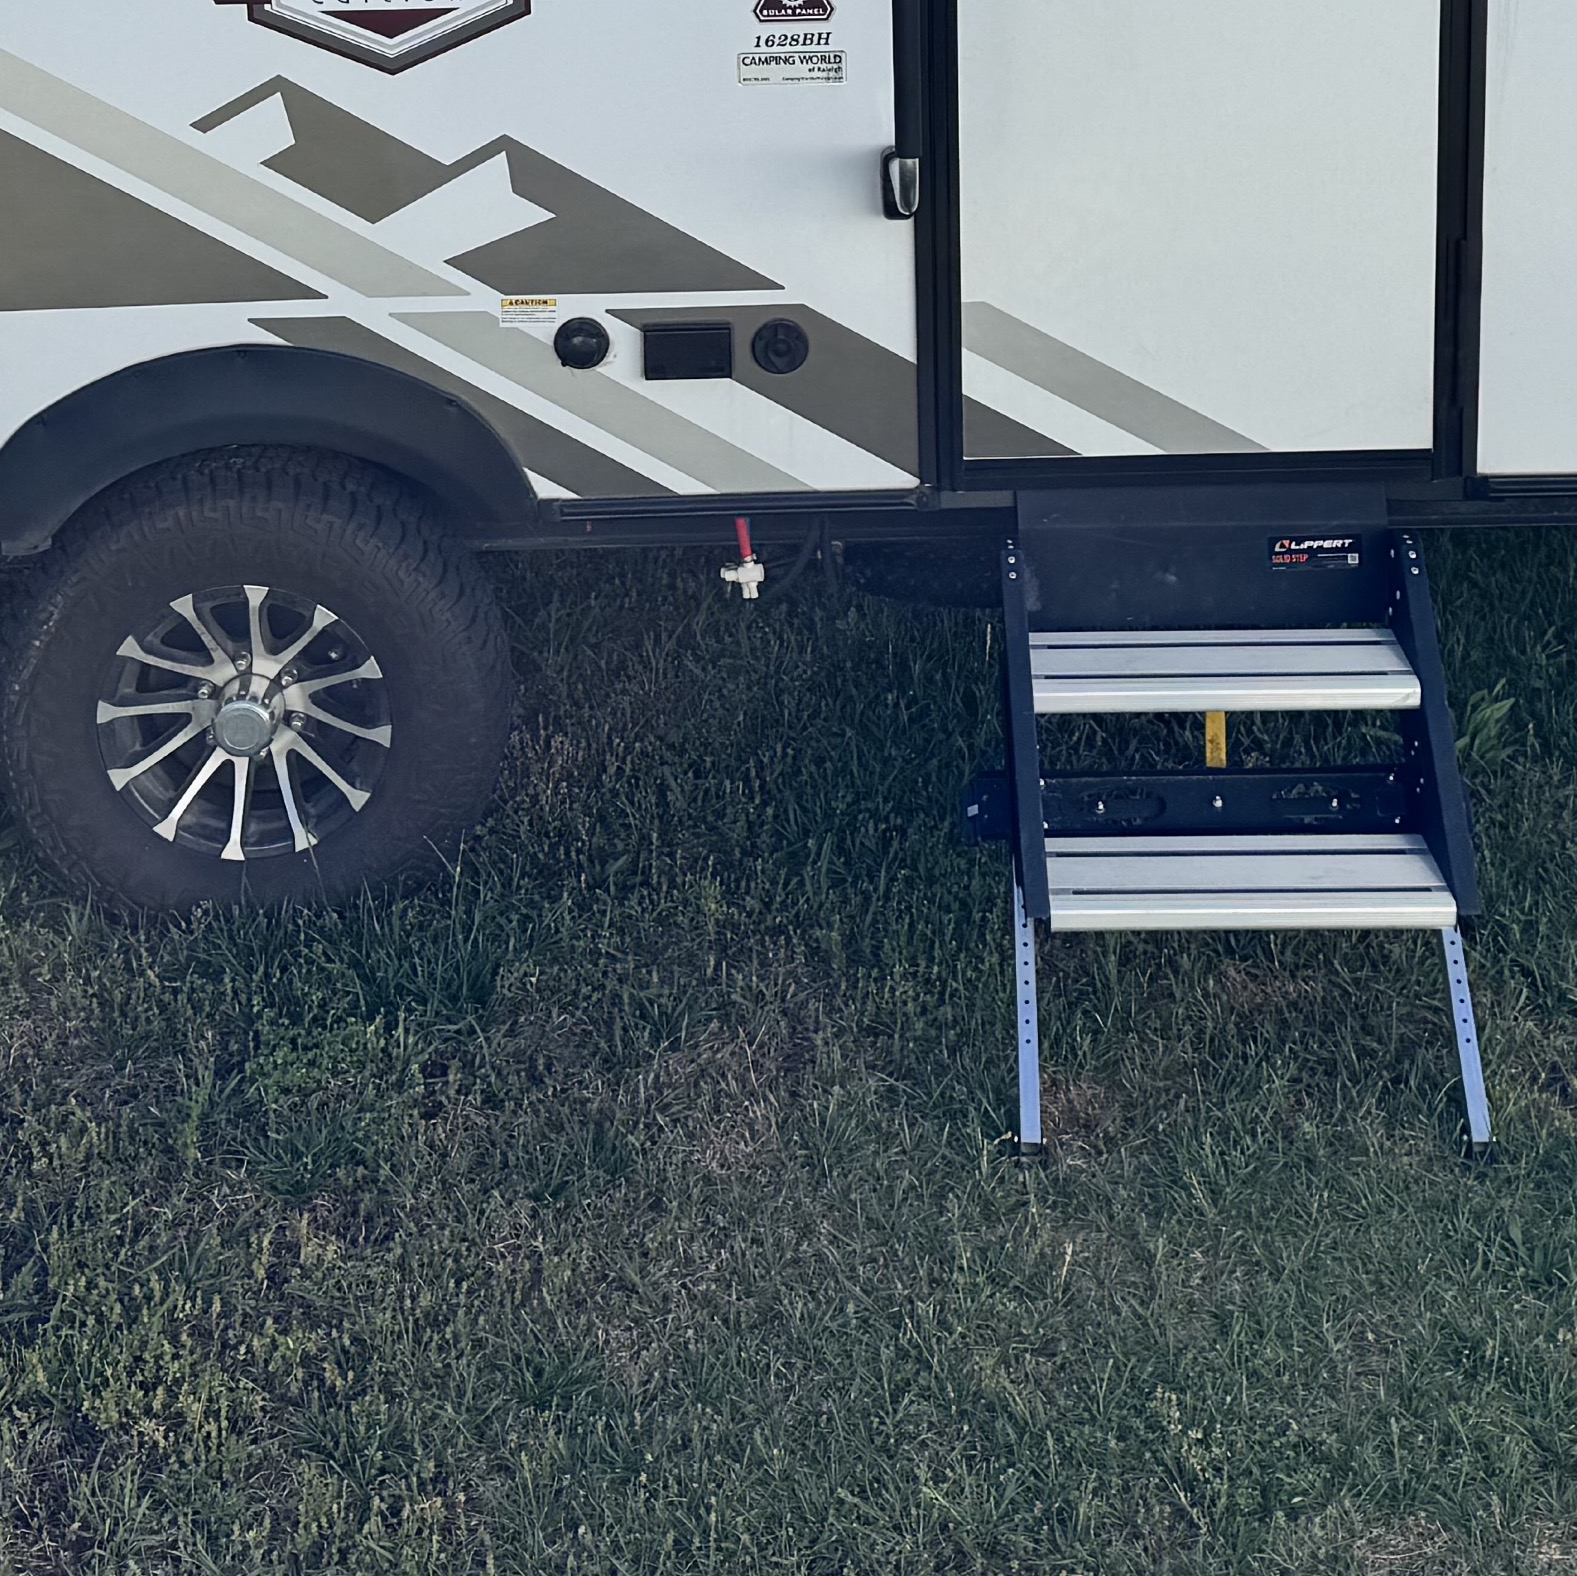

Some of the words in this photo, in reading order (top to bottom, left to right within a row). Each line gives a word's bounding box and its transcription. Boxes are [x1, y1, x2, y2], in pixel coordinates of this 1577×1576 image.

[753, 31, 833, 48] 1628BH
[741, 55, 796, 67] CAMPING
[798, 53, 843, 65] WORLD
